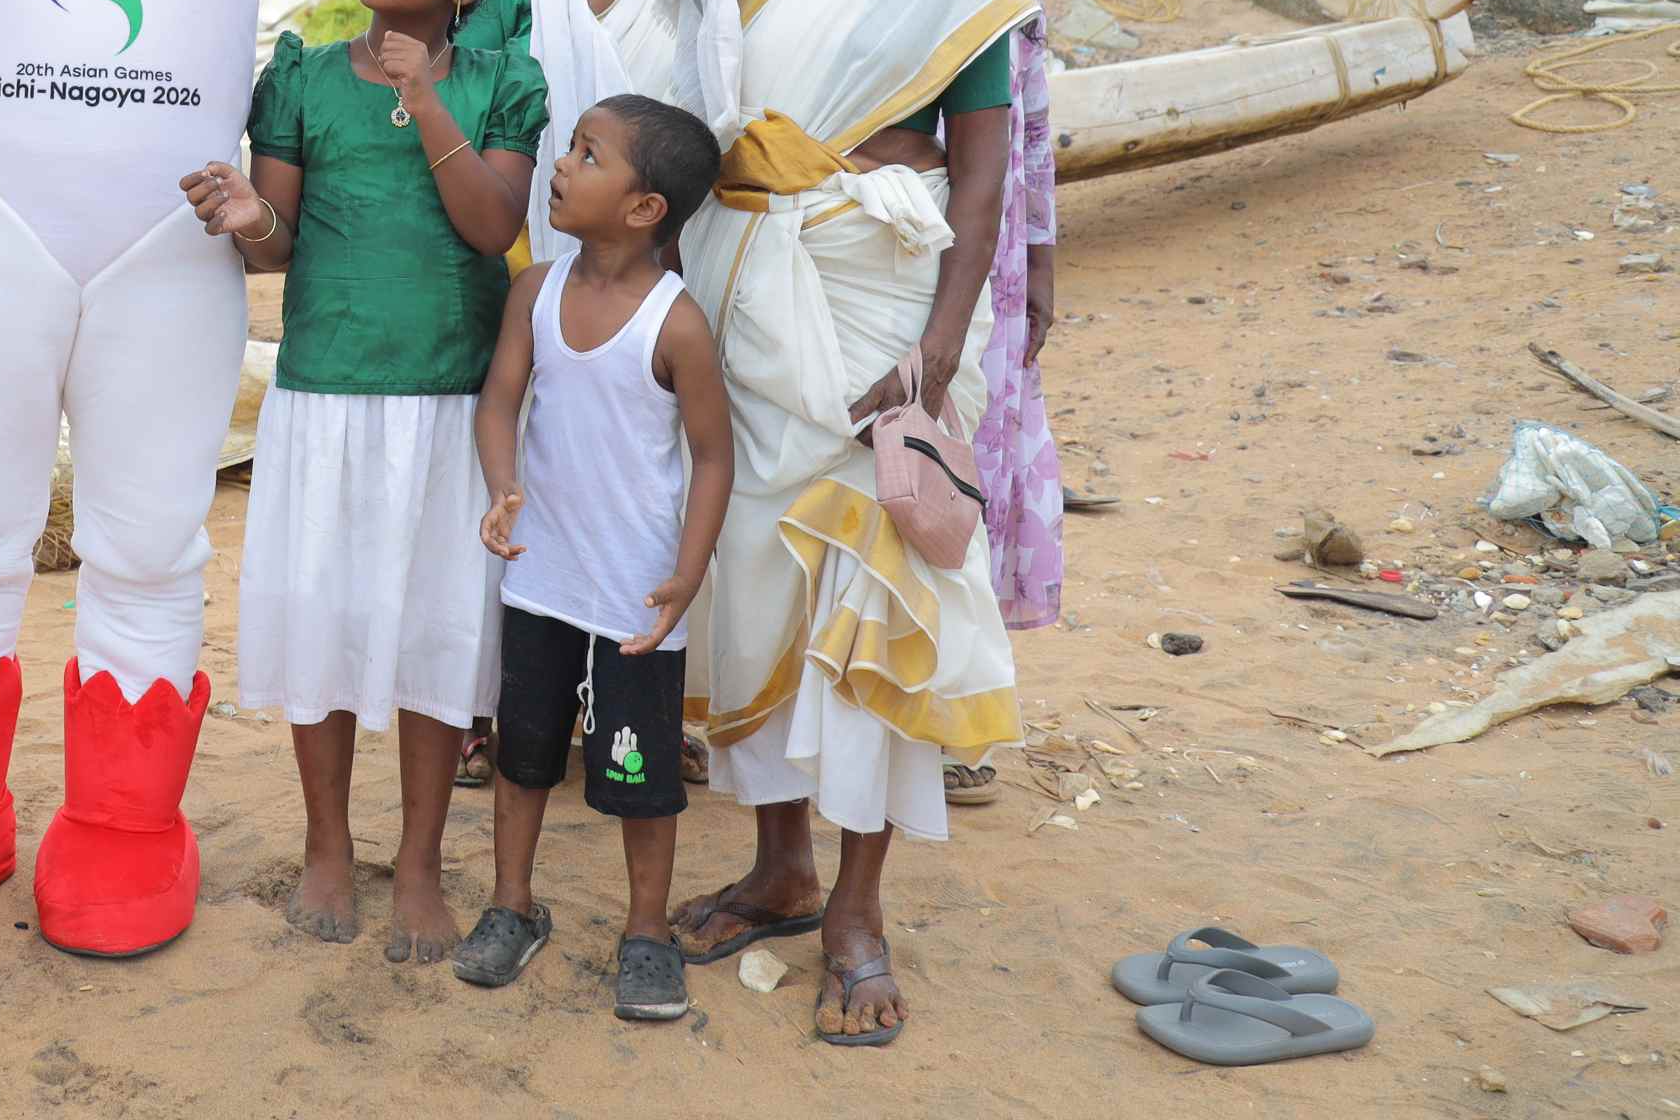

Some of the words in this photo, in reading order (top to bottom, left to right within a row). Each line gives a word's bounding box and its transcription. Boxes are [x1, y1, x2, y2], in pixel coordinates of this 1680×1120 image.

[15, 63, 54, 77] 20th
[59, 64, 108, 79] Asian
[114, 66, 172, 82] Games
[152, 86, 201, 106] 2026
